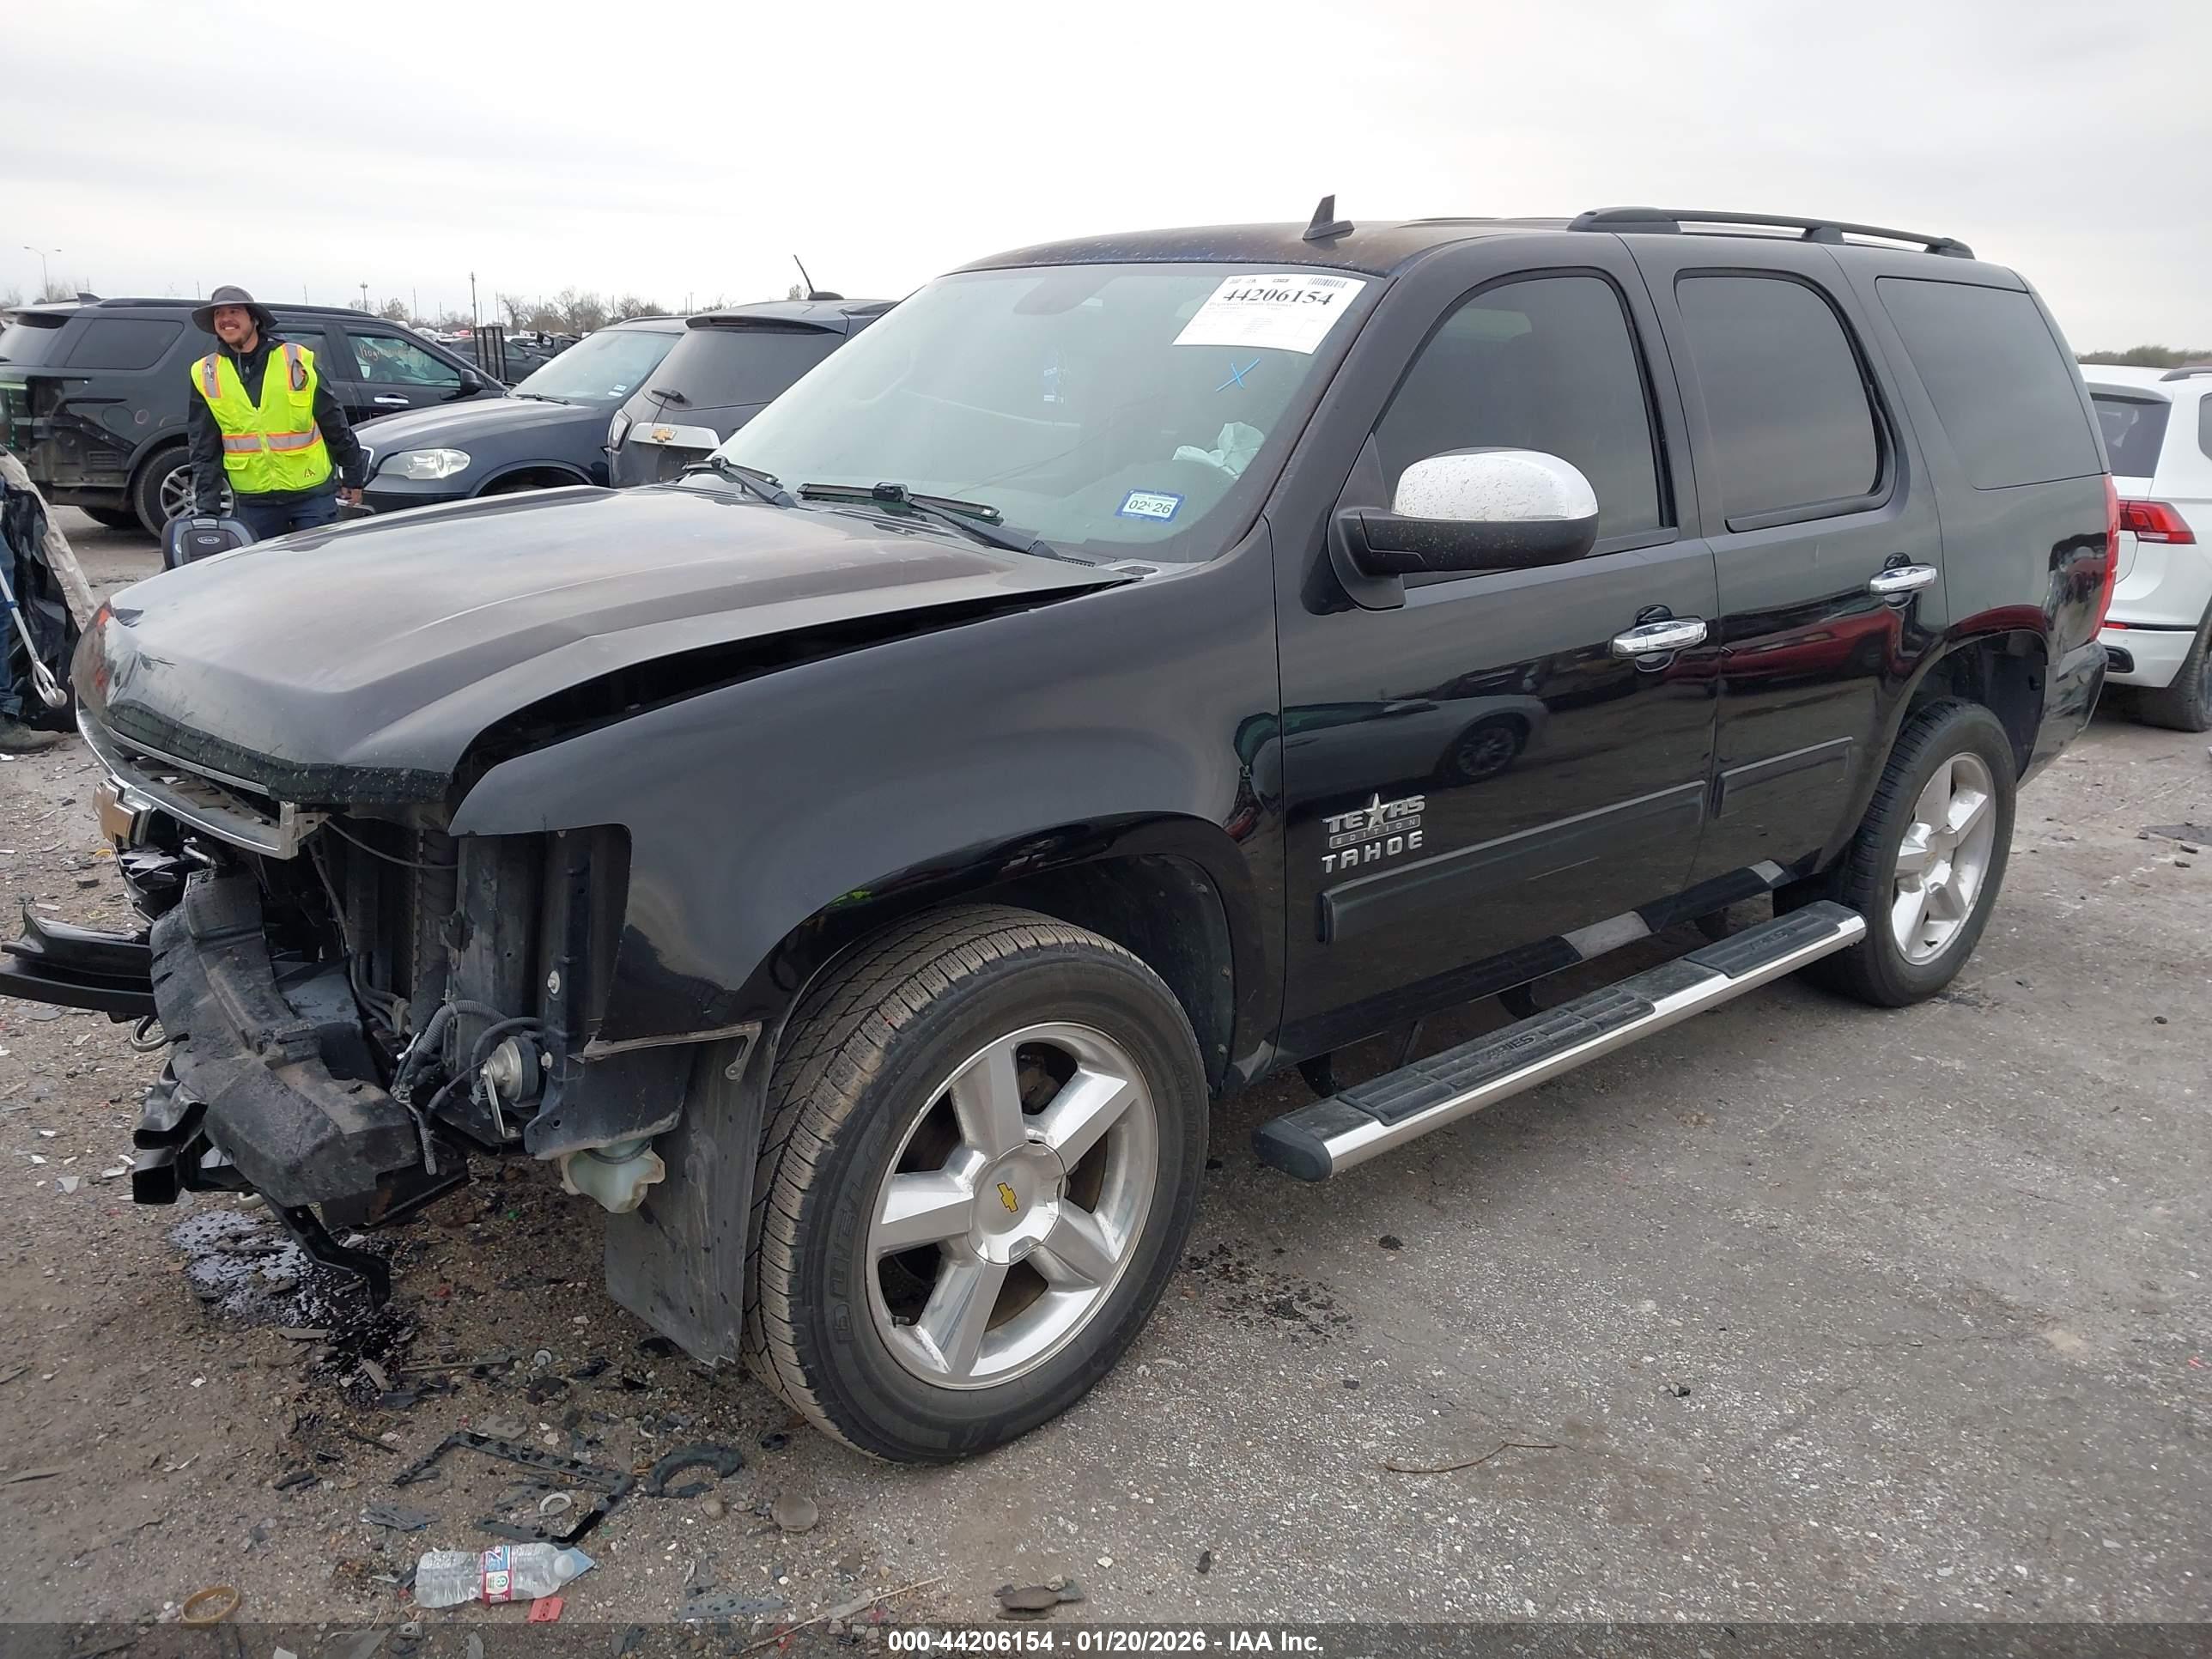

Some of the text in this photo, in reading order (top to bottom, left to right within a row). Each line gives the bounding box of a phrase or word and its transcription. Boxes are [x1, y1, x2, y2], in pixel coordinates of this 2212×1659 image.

[1223, 288, 1335, 306] 44206154
[1128, 500, 1173, 514] 02 26
[1335, 818, 1417, 846] EDITION
[1321, 830, 1424, 873] TAHOE
